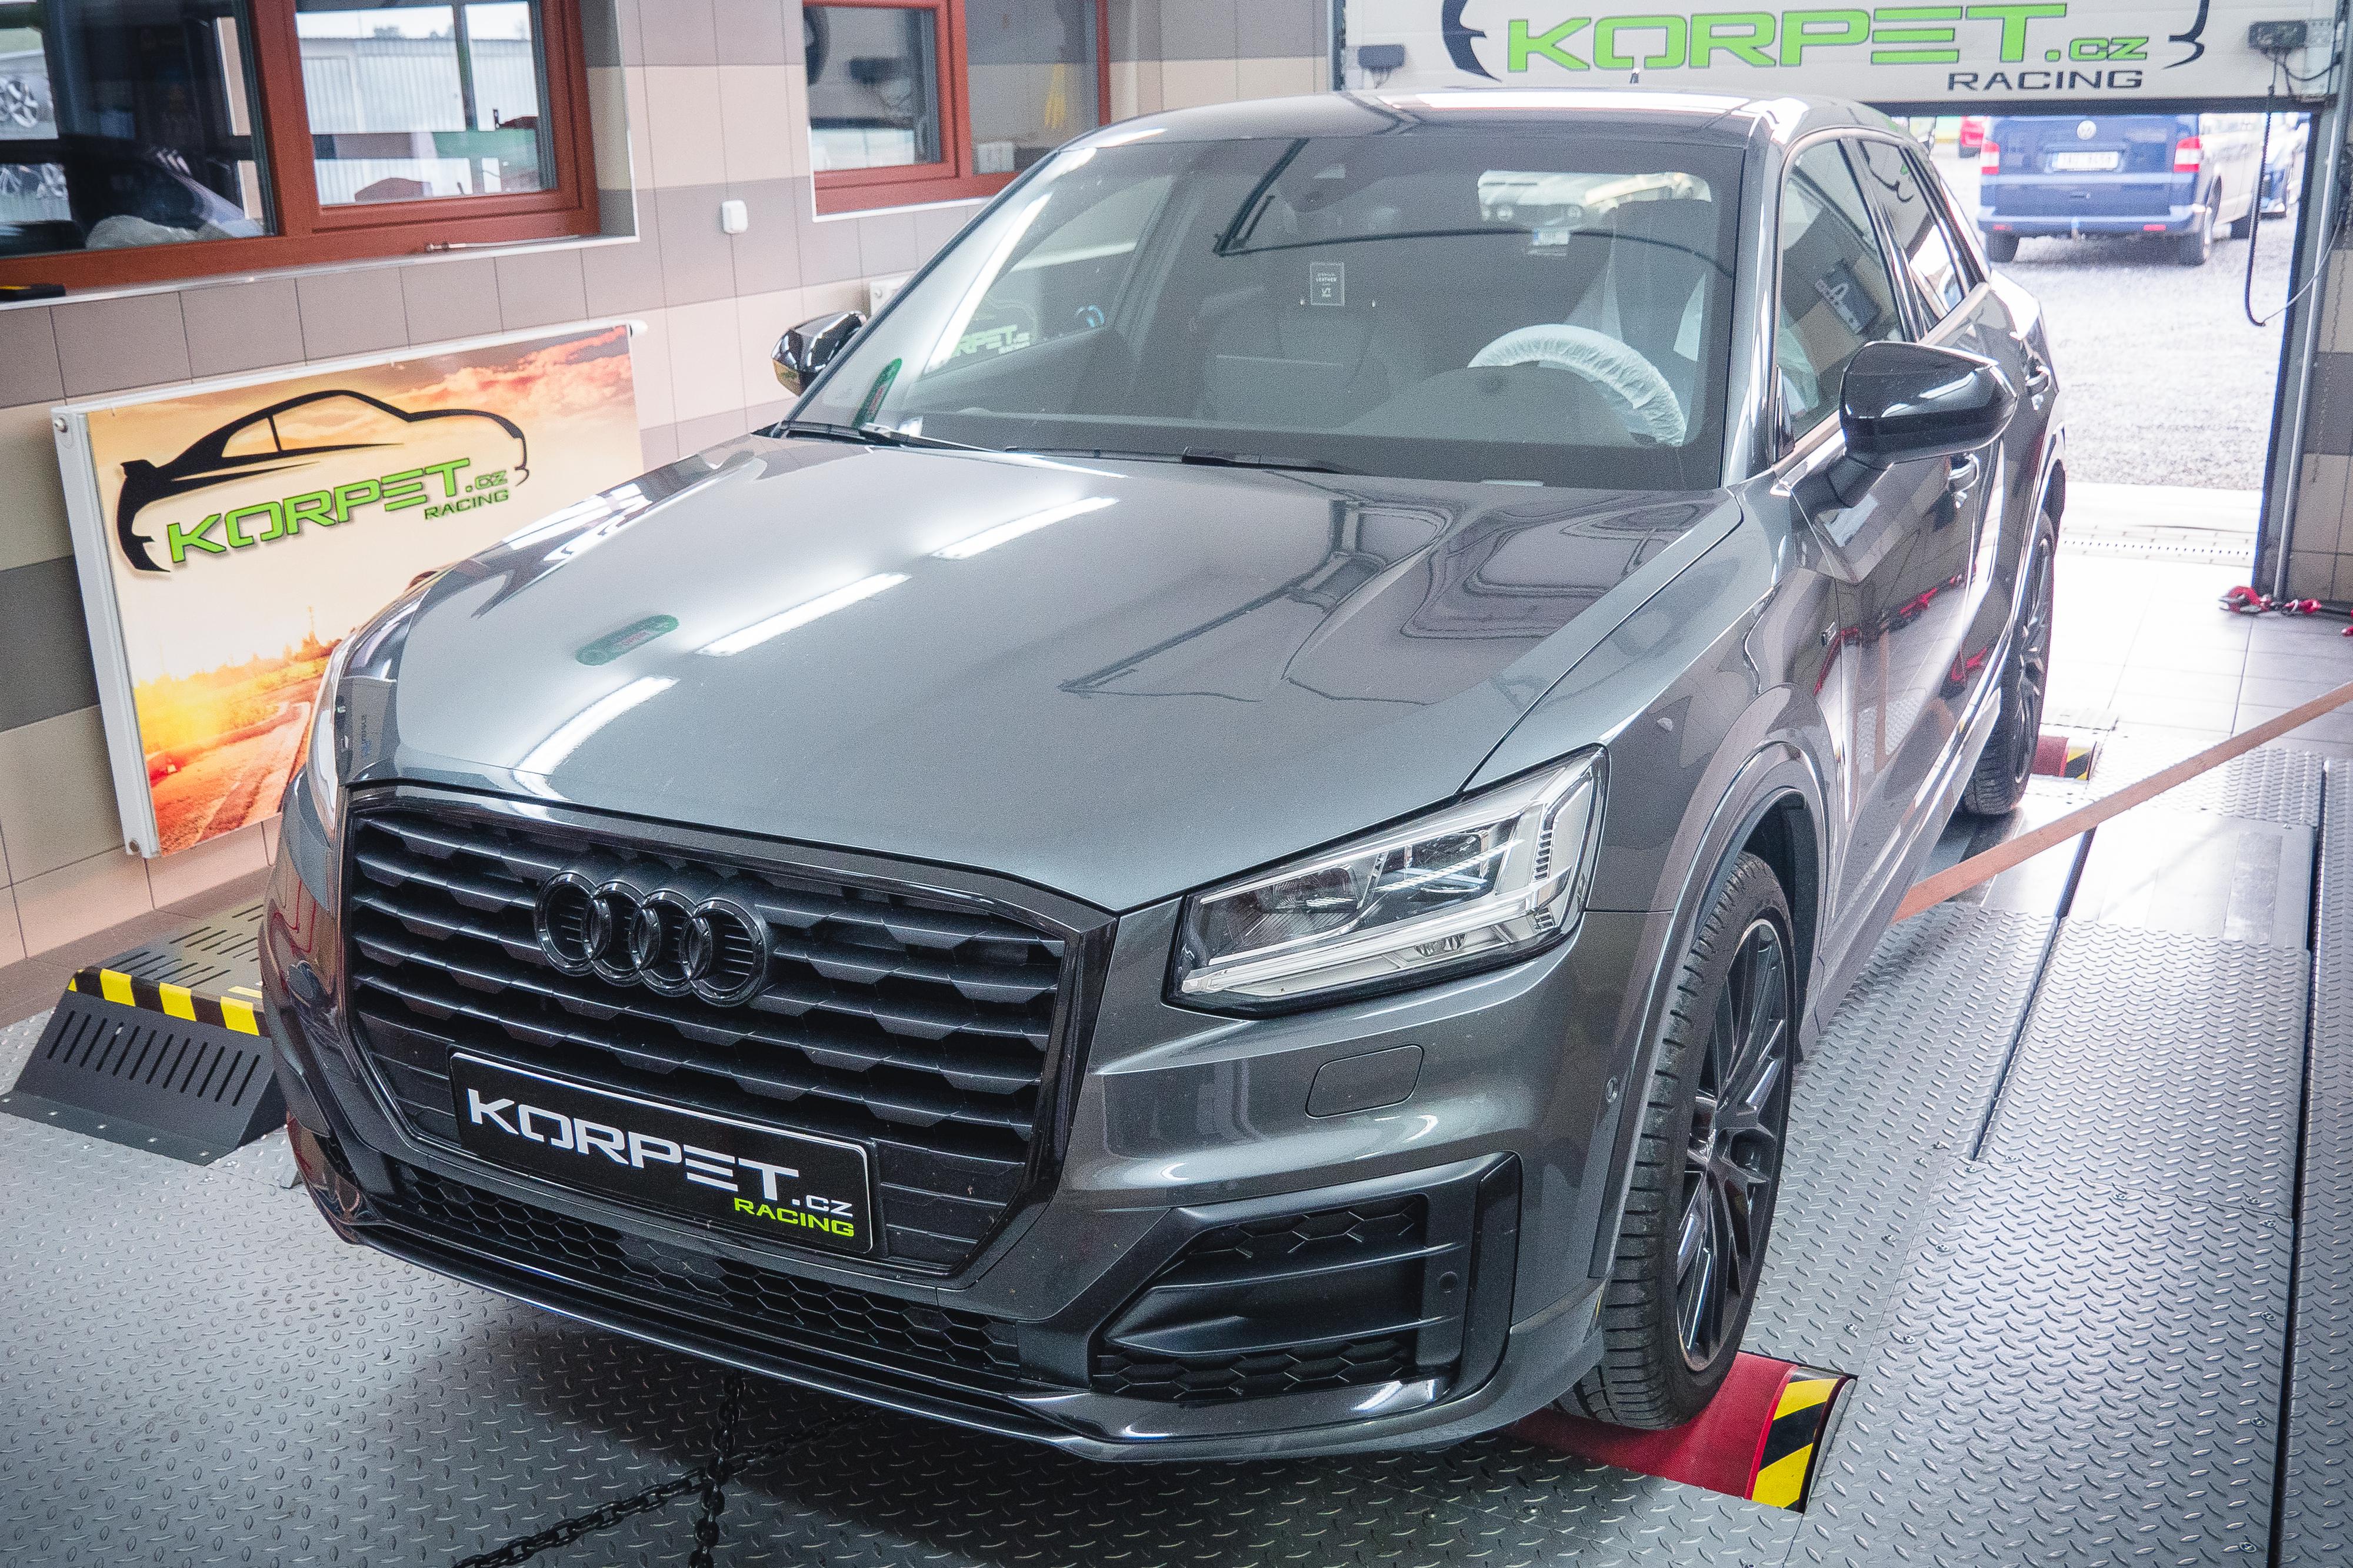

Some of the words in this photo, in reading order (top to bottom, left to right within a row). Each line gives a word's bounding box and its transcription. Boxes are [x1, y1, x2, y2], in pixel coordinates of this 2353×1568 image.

[1947, 70, 2143, 91] RACING
[424, 489, 509, 520] RACING
[734, 1197, 855, 1237] RACING
